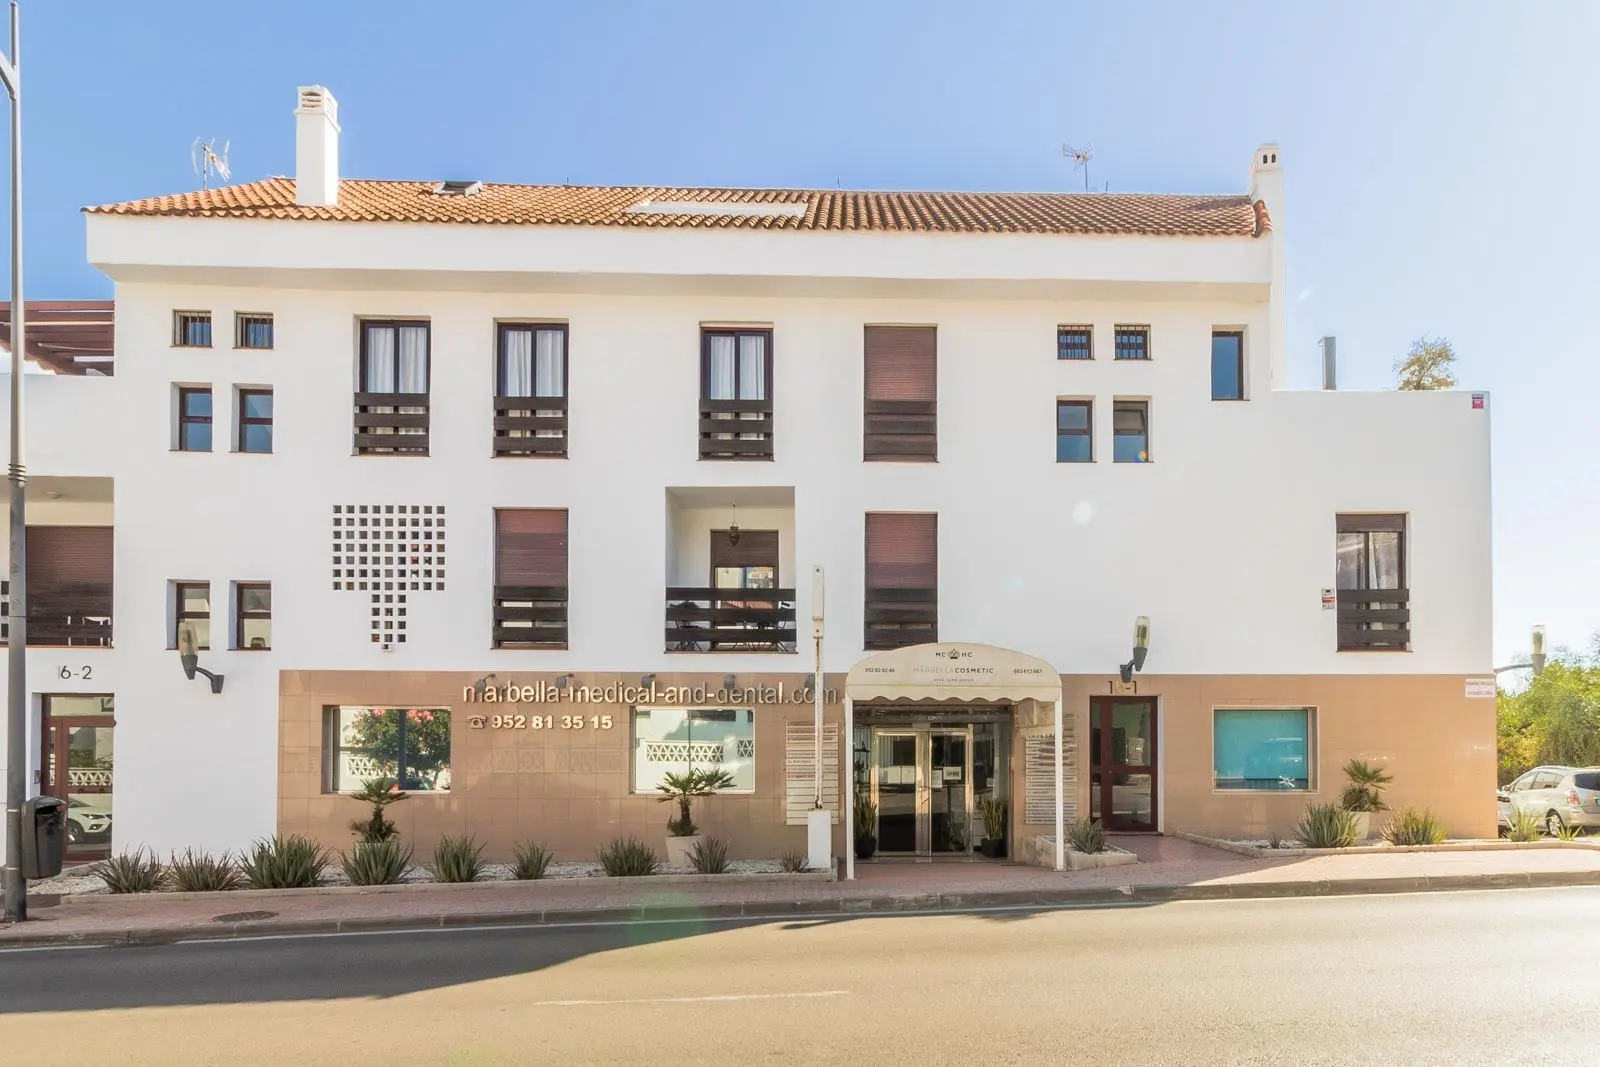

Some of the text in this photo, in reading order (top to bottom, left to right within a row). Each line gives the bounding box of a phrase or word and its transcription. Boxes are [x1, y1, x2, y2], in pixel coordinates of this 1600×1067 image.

[491, 714, 613, 729] 952 81 35 15
